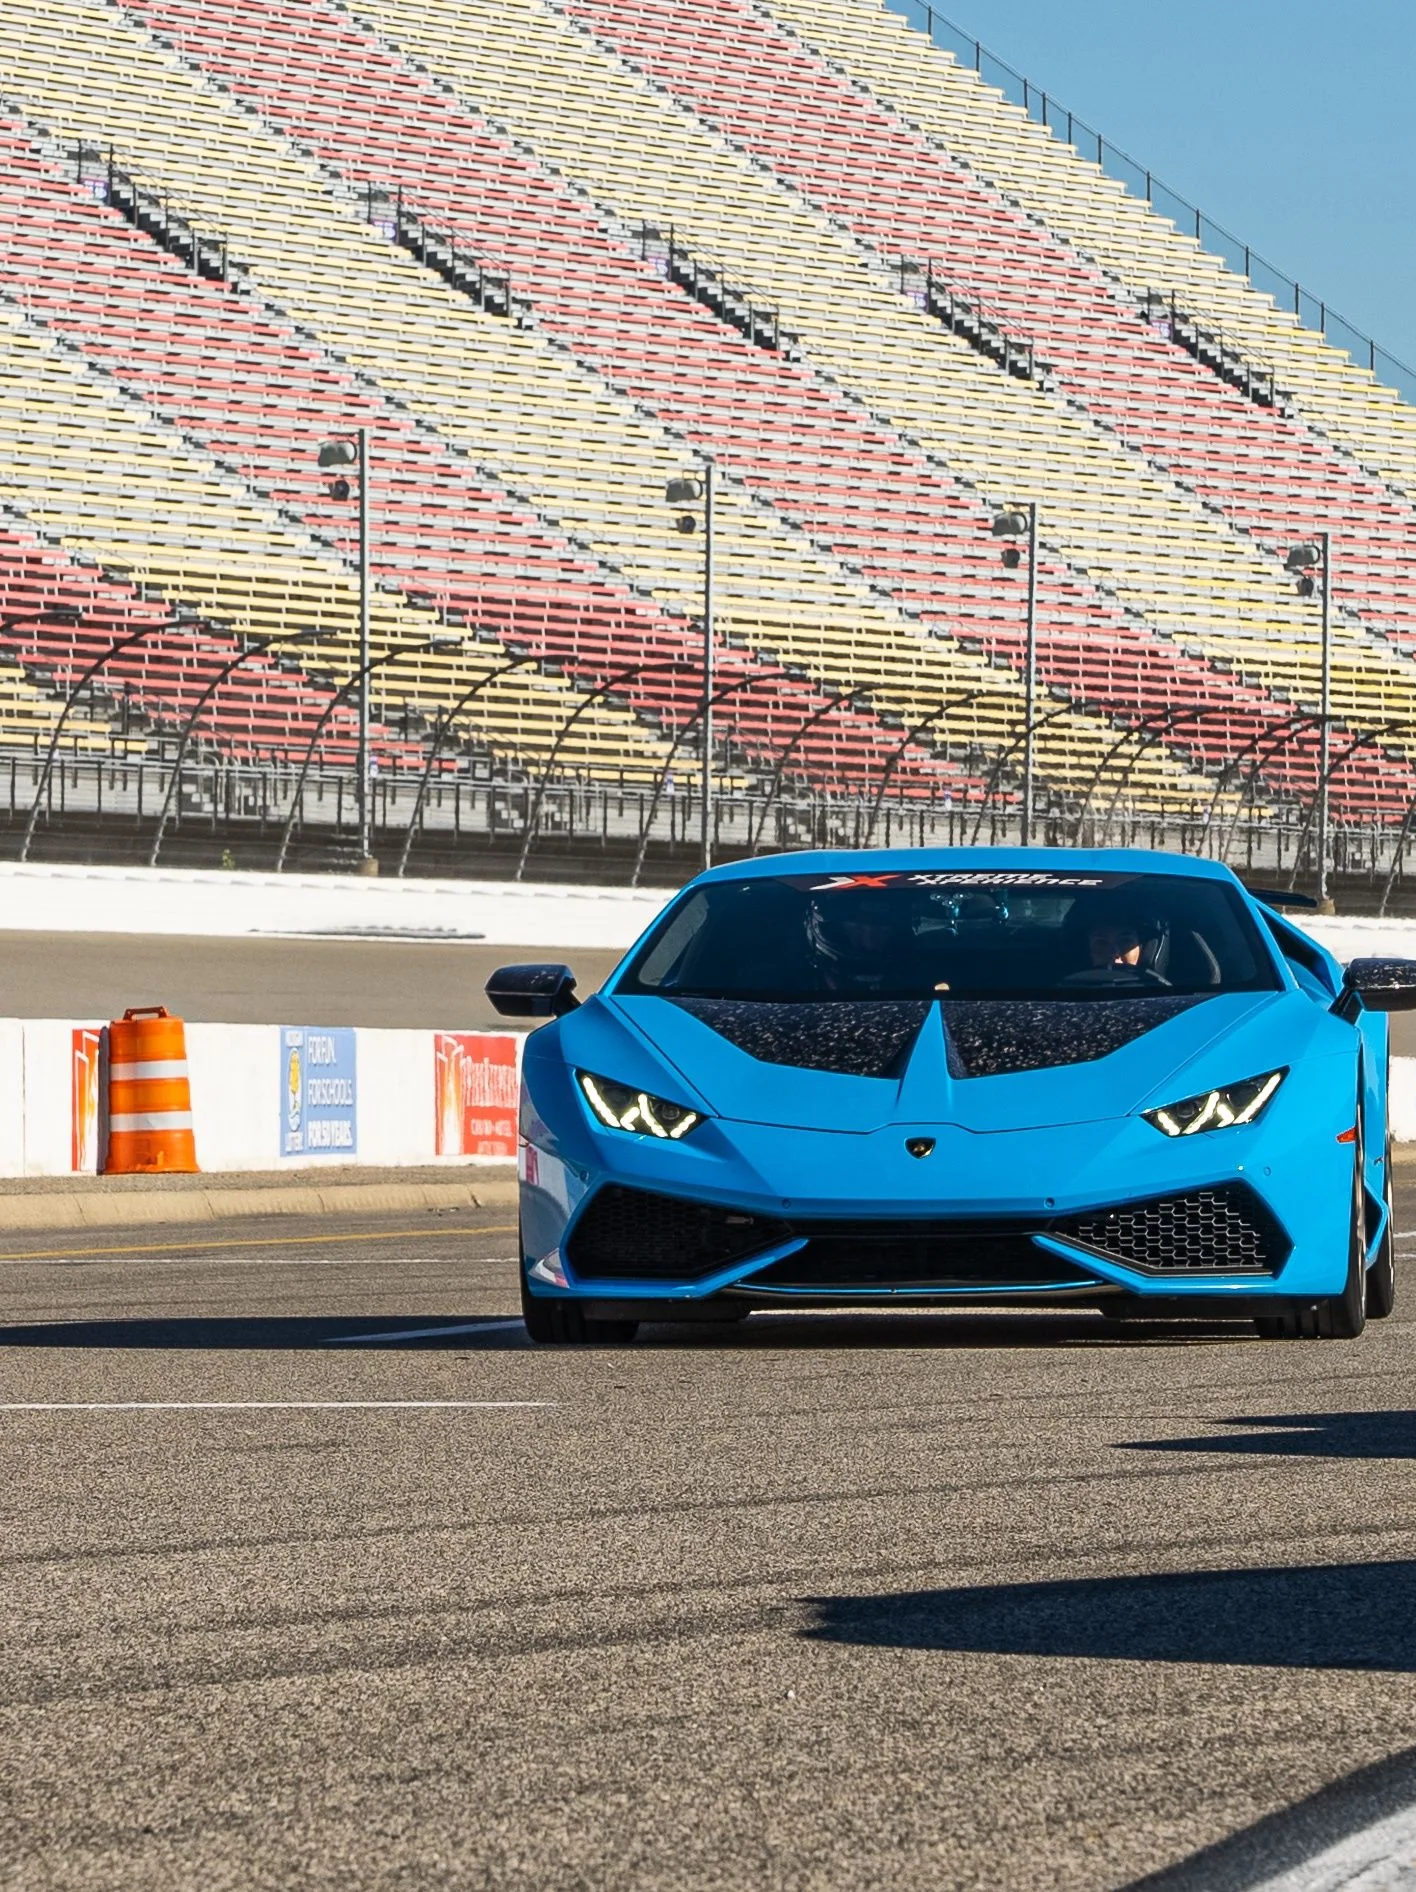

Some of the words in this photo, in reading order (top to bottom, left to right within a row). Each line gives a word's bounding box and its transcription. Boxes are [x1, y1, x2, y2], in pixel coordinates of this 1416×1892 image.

[907, 873, 1053, 881] XTREME
[916, 878, 1104, 886] XPERIENCE
[307, 1036, 322, 1064] FOR
